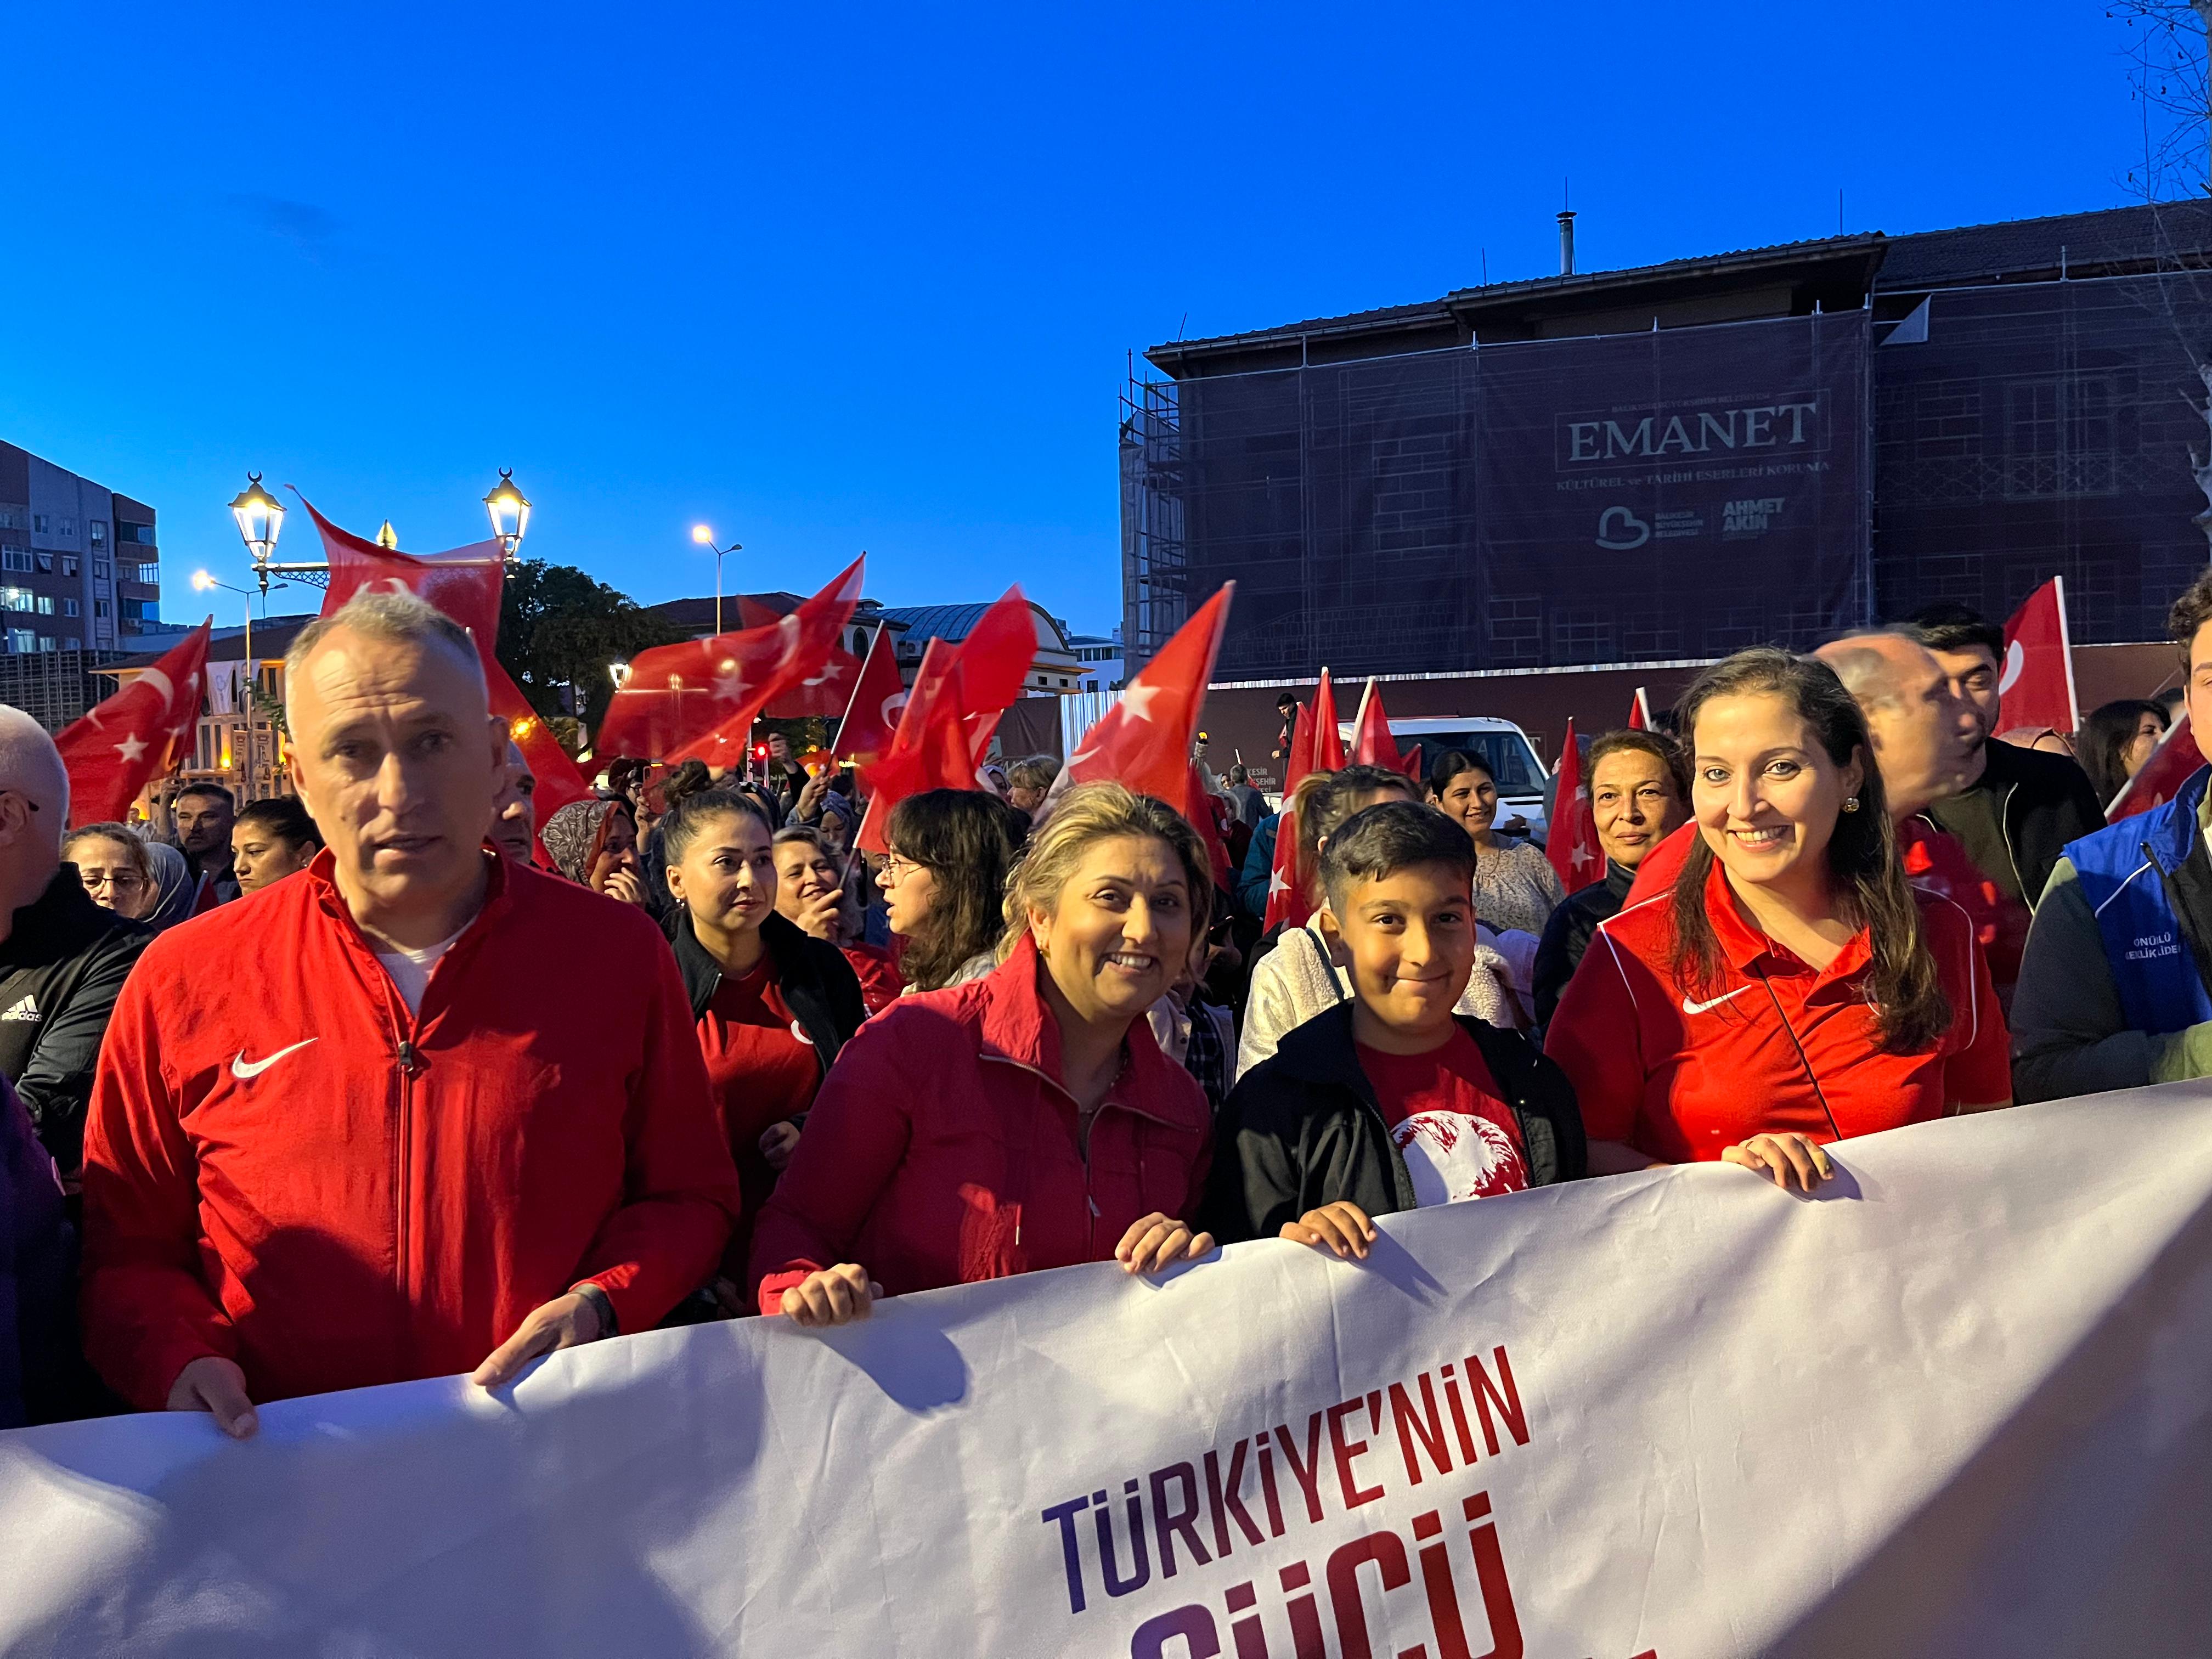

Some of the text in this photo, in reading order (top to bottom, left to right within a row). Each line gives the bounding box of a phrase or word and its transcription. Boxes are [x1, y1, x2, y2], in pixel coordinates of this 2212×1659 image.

[1567, 403, 1816, 462] EMANET
[1555, 476, 1624, 492] KÜLTÜREL
[1646, 470, 1693, 484] TARİHİ
[1696, 465, 1763, 482] ESERLERİ
[1722, 497, 1785, 517] AHMET
[1, 1010, 43, 1022] adidas
[1042, 1344, 1531, 1614] TÜRKİYE'NİN
